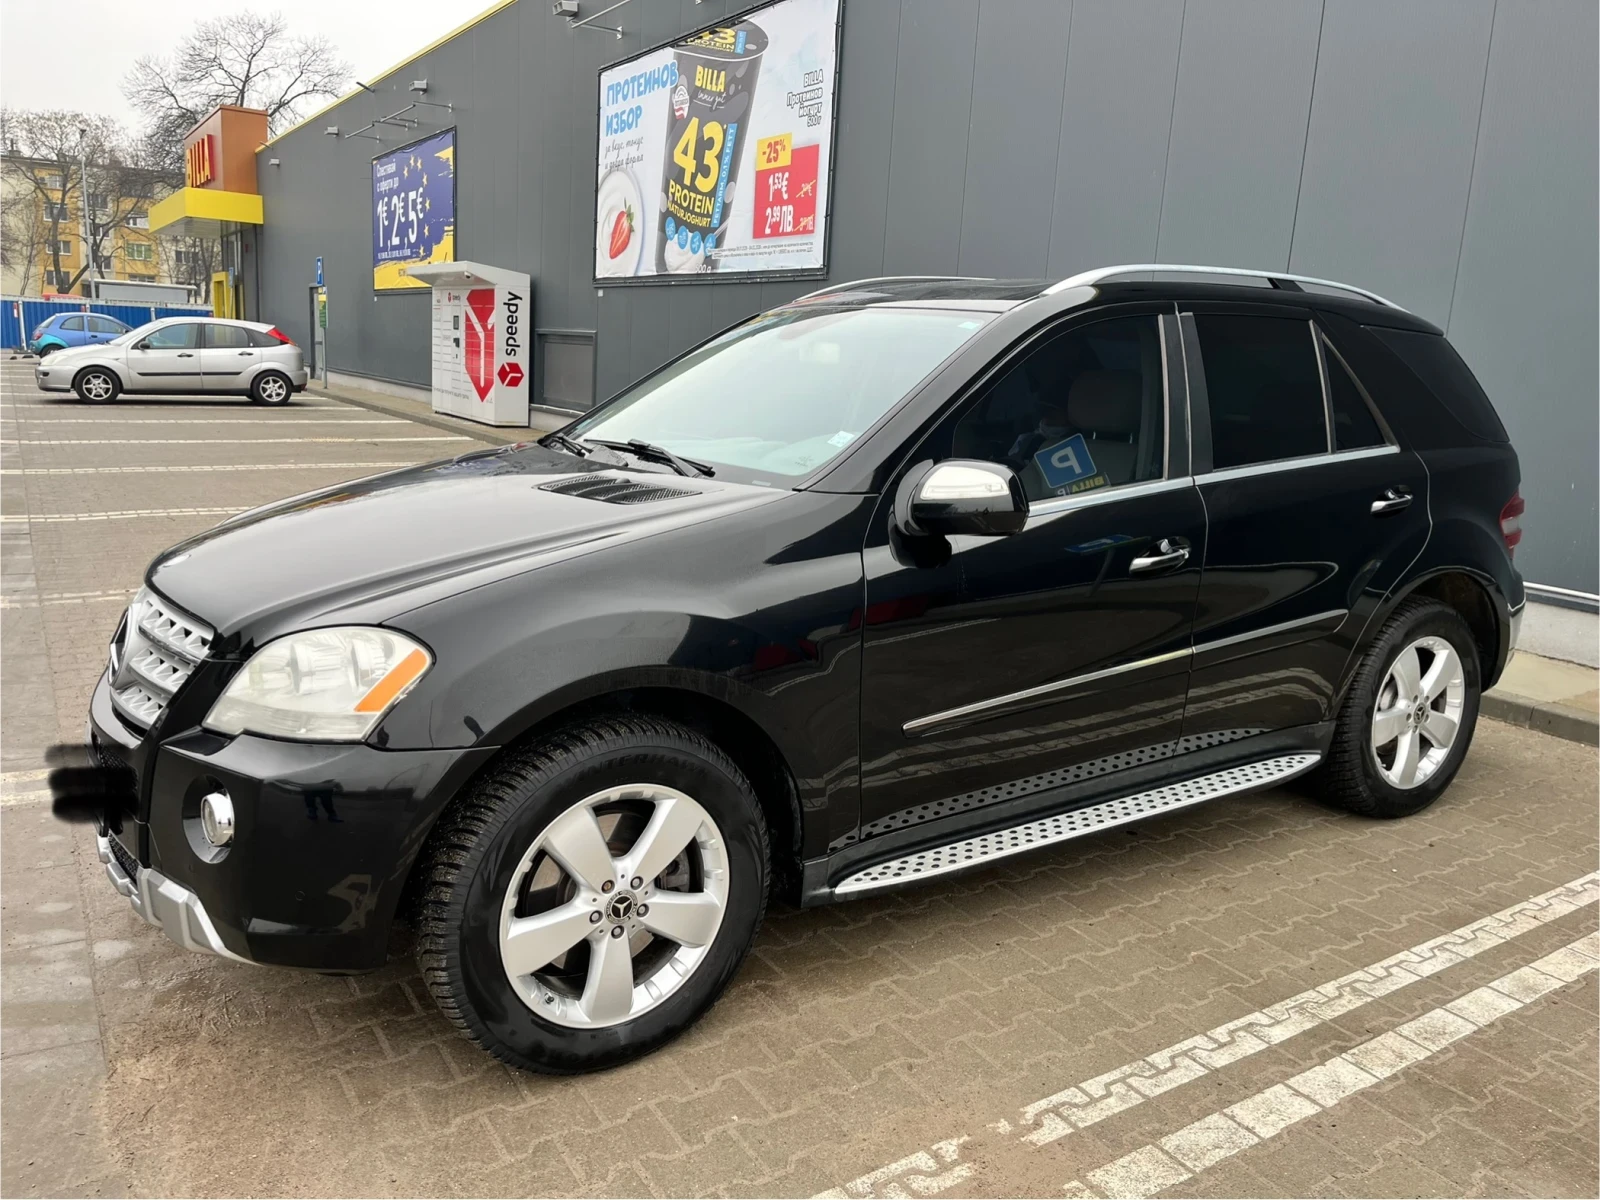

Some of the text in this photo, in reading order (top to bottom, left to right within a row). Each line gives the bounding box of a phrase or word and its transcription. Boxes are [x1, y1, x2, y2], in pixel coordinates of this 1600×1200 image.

[606, 61, 678, 106] ПРОТЕИНОВ
[695, 65, 725, 92] BILLA
[803, 69, 823, 88] BILLA
[787, 87, 823, 109] Протеинов
[605, 105, 643, 137] ИЗБОР
[186, 134, 213, 188] BILLA
[673, 116, 724, 193] 43
[762, 139, 786, 164] -25%
[669, 179, 715, 215] PROTEIN
[668, 200, 712, 228] NATURJOGHURT
[503, 291, 522, 356] speedy
